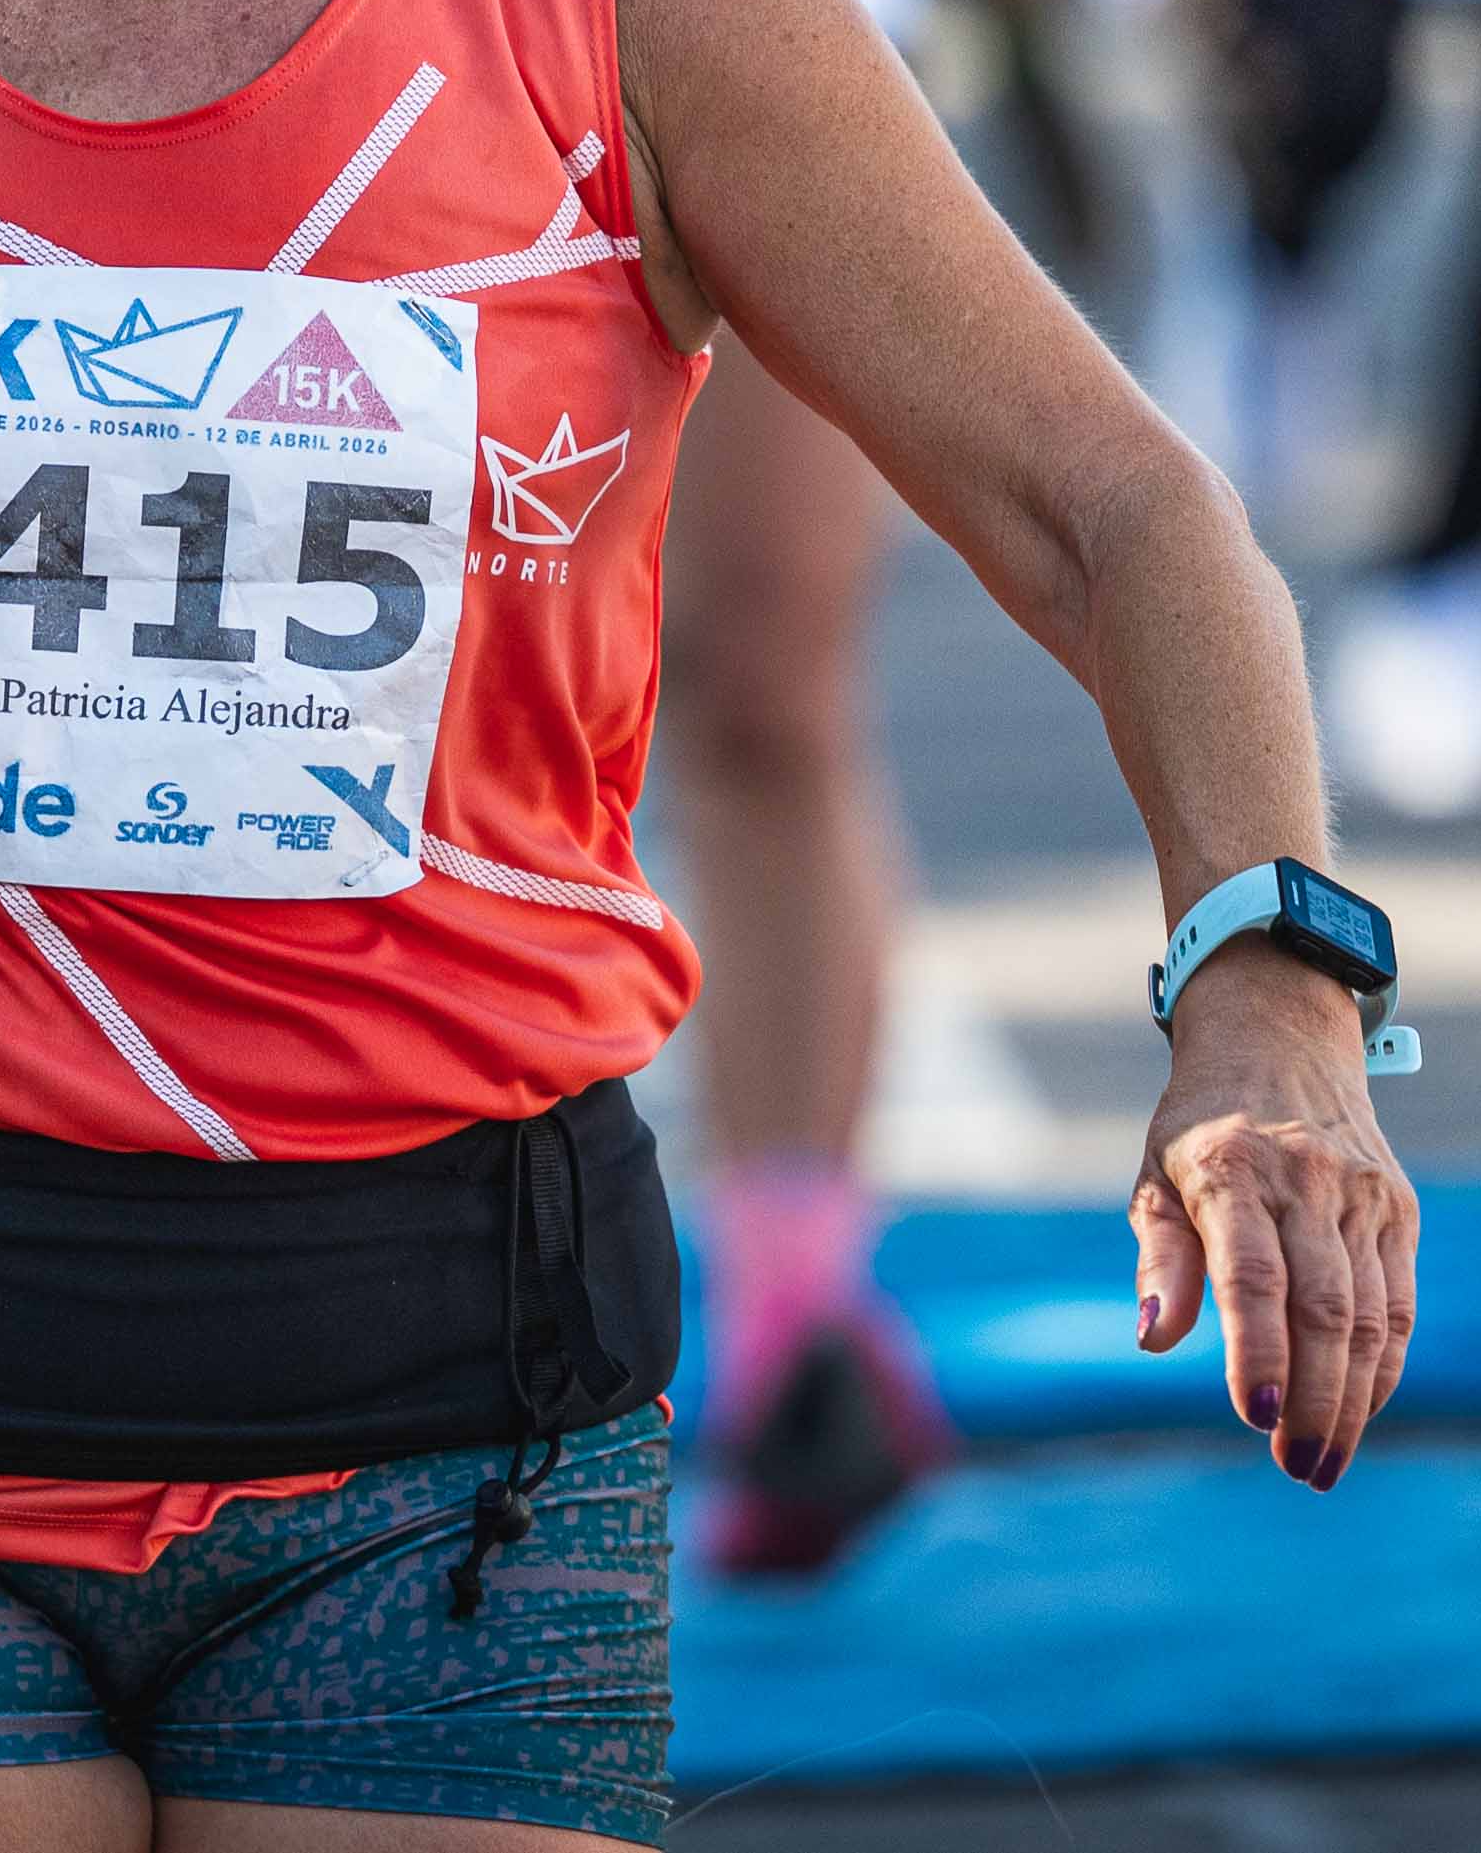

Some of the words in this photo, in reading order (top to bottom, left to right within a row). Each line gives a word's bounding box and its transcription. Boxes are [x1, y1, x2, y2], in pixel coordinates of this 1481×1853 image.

[272, 366, 362, 412] 15K
[14, 413, 66, 434] 2026
[88, 418, 181, 441] ROSARIO
[204, 426, 227, 444] 12
[235, 428, 262, 446] DE
[269, 432, 331, 452] ABRIL
[338, 435, 389, 456] 2026
[467, 551, 570, 585] NORTE
[158, 686, 352, 737] Alejandra
[236, 812, 337, 832] POWER
